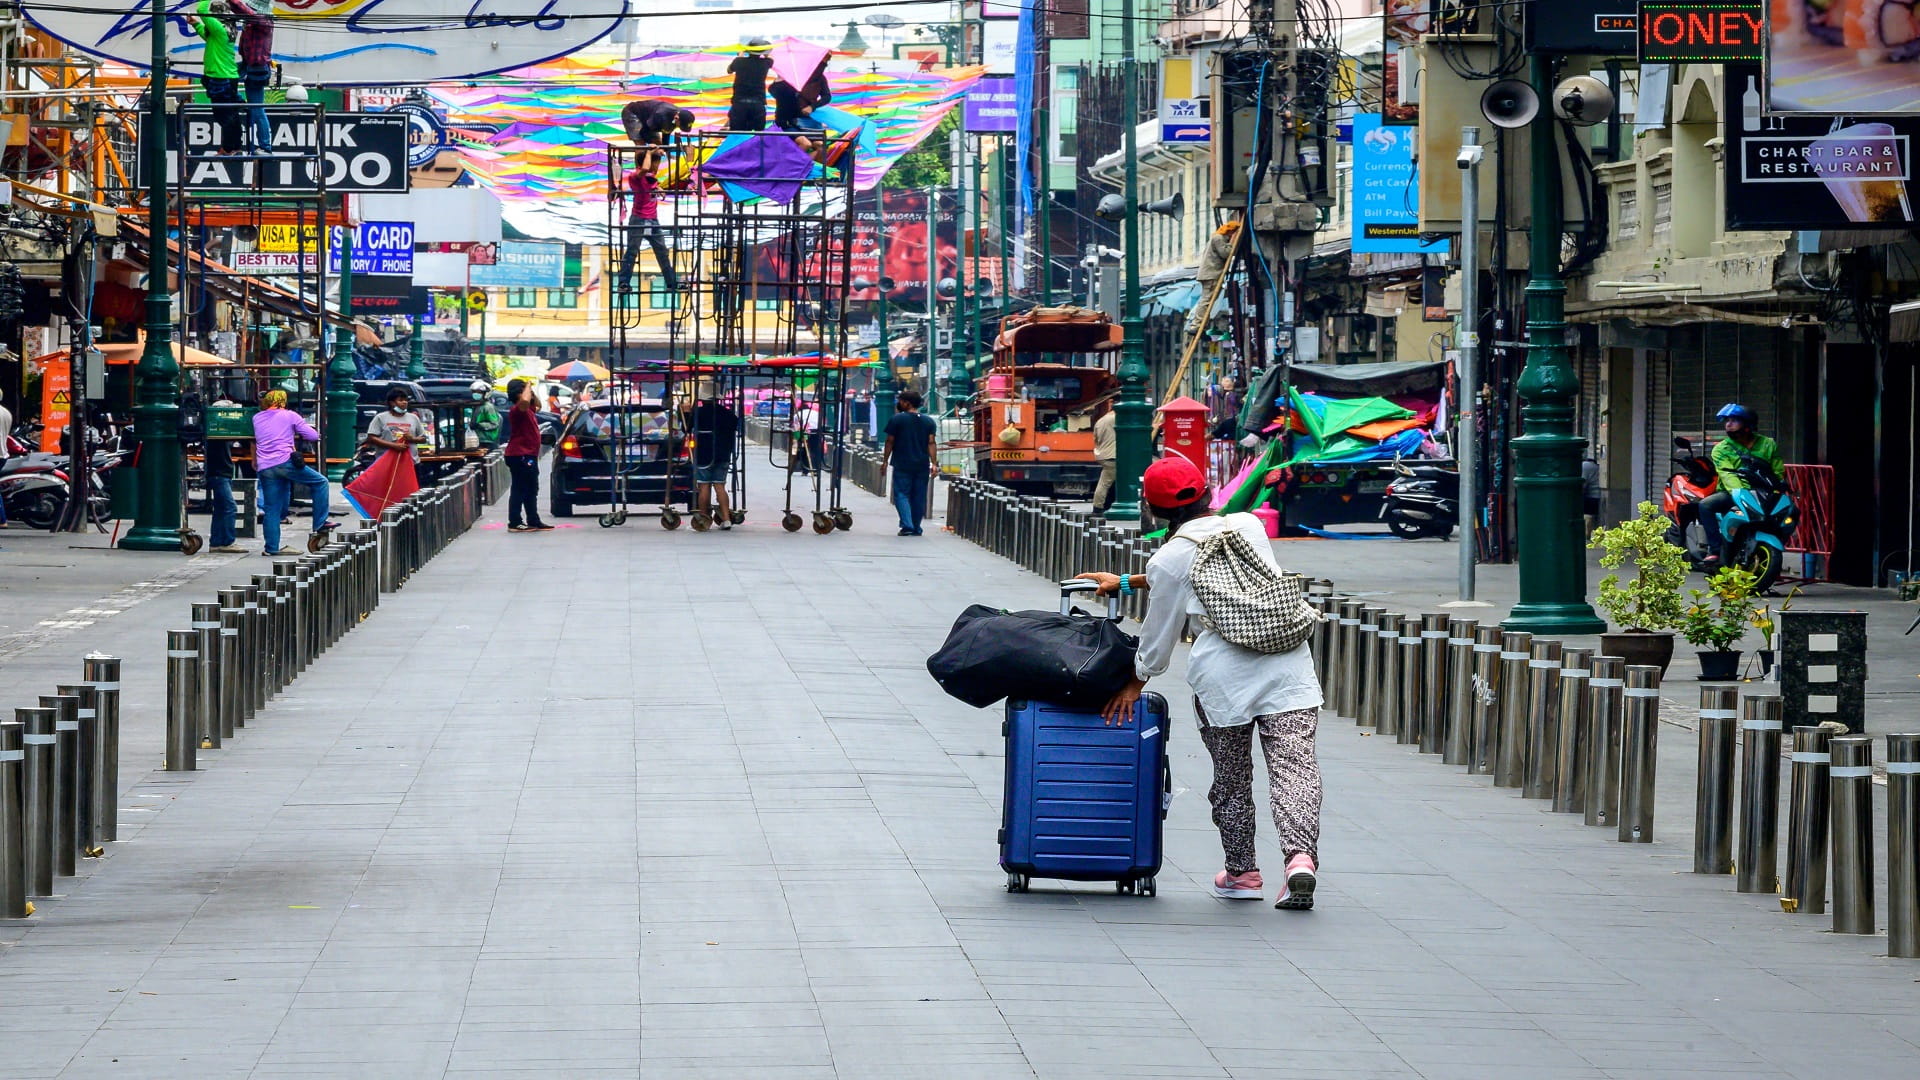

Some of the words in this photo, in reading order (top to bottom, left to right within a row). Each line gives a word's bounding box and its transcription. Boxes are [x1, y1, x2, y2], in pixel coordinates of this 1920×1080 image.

[1644, 13, 1763, 45] ONEY
[1759, 148, 1825, 157] CHART
[1834, 147, 1873, 156] BAR
[1882, 146, 1894, 155] &
[1365, 162, 1412, 172] Currency
[1760, 162, 1894, 173] RESTAURANT
[1364, 178, 1383, 187] Get
[1364, 193, 1386, 201] ATM
[1364, 208, 1382, 217] Bill
[261, 226, 285, 243] VISA
[368, 226, 413, 250] CARD
[238, 254, 270, 265] BEST
[382, 260, 412, 272] PHONE
